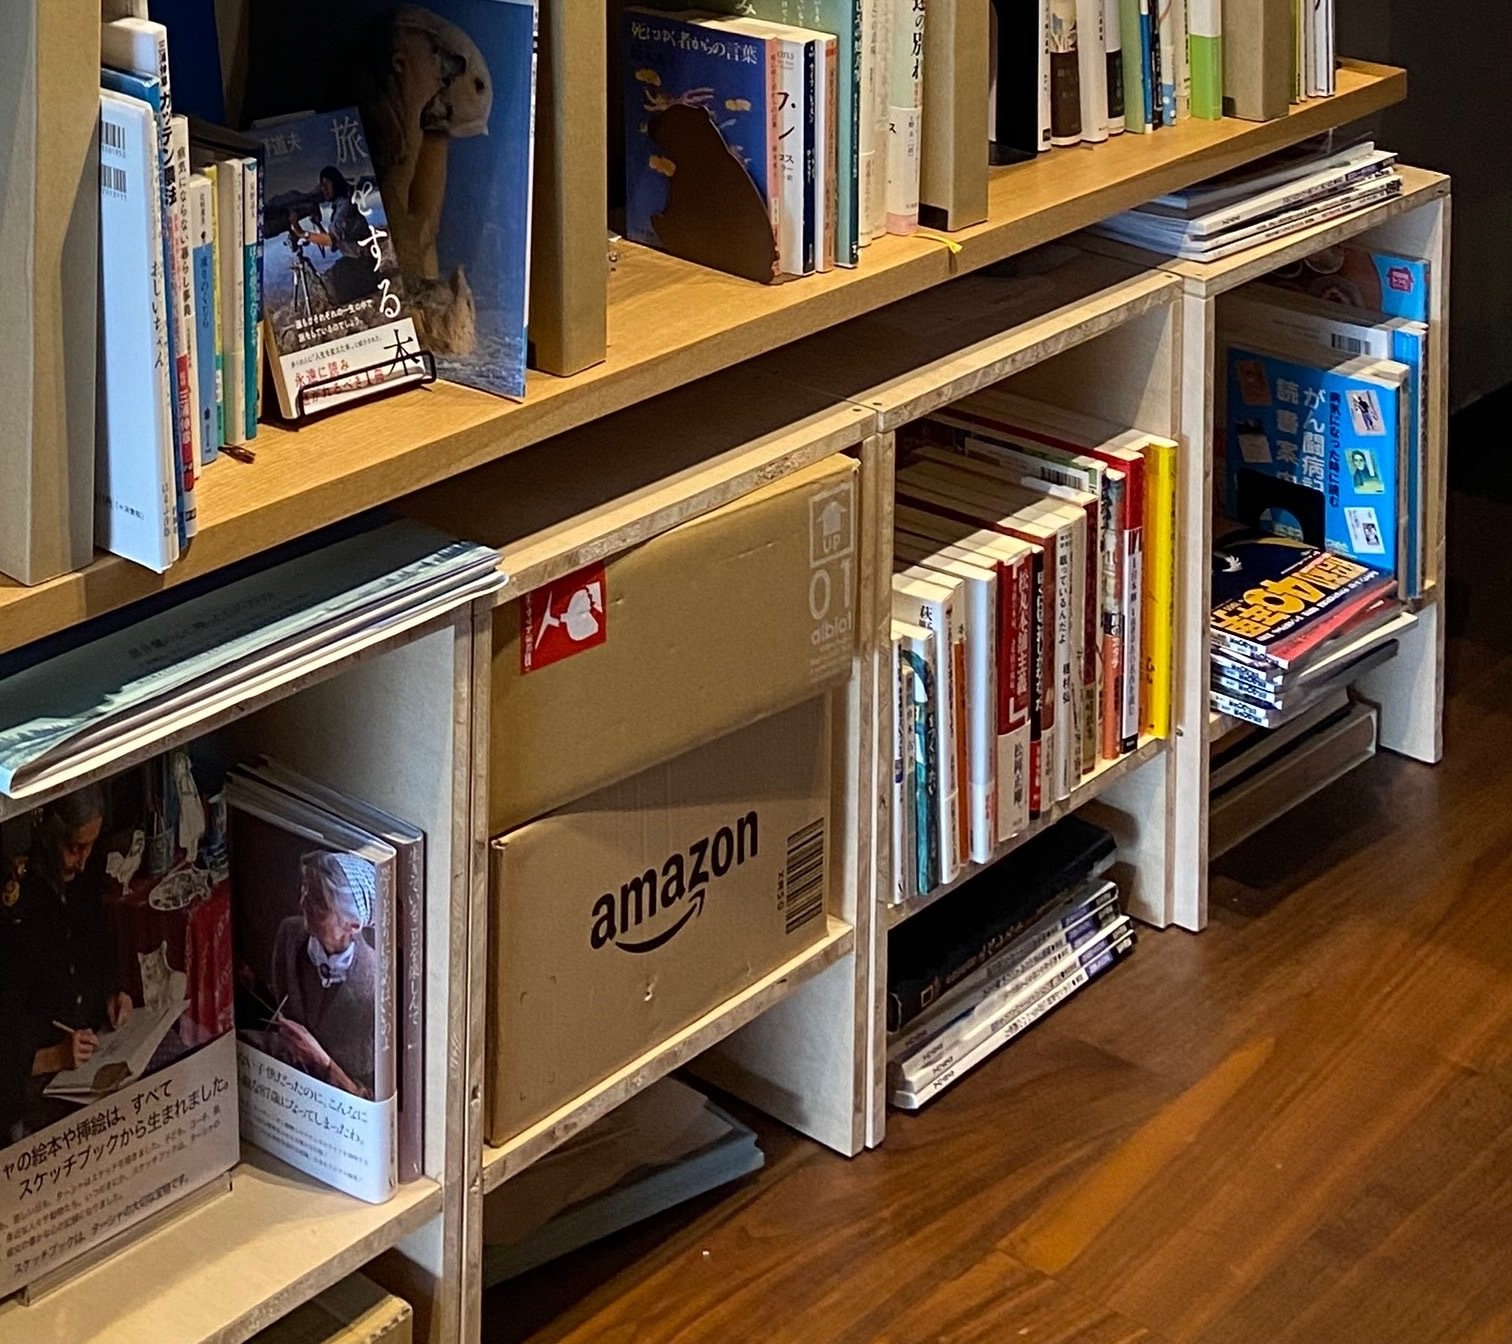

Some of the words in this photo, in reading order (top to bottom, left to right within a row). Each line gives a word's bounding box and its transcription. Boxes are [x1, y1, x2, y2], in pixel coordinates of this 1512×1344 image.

[630, 20, 759, 66] 死にゆく者からの言葉
[821, 534, 842, 552] UP
[591, 809, 760, 951] amazon
[19, 1076, 230, 1200] スケッチブックから生まれました。
